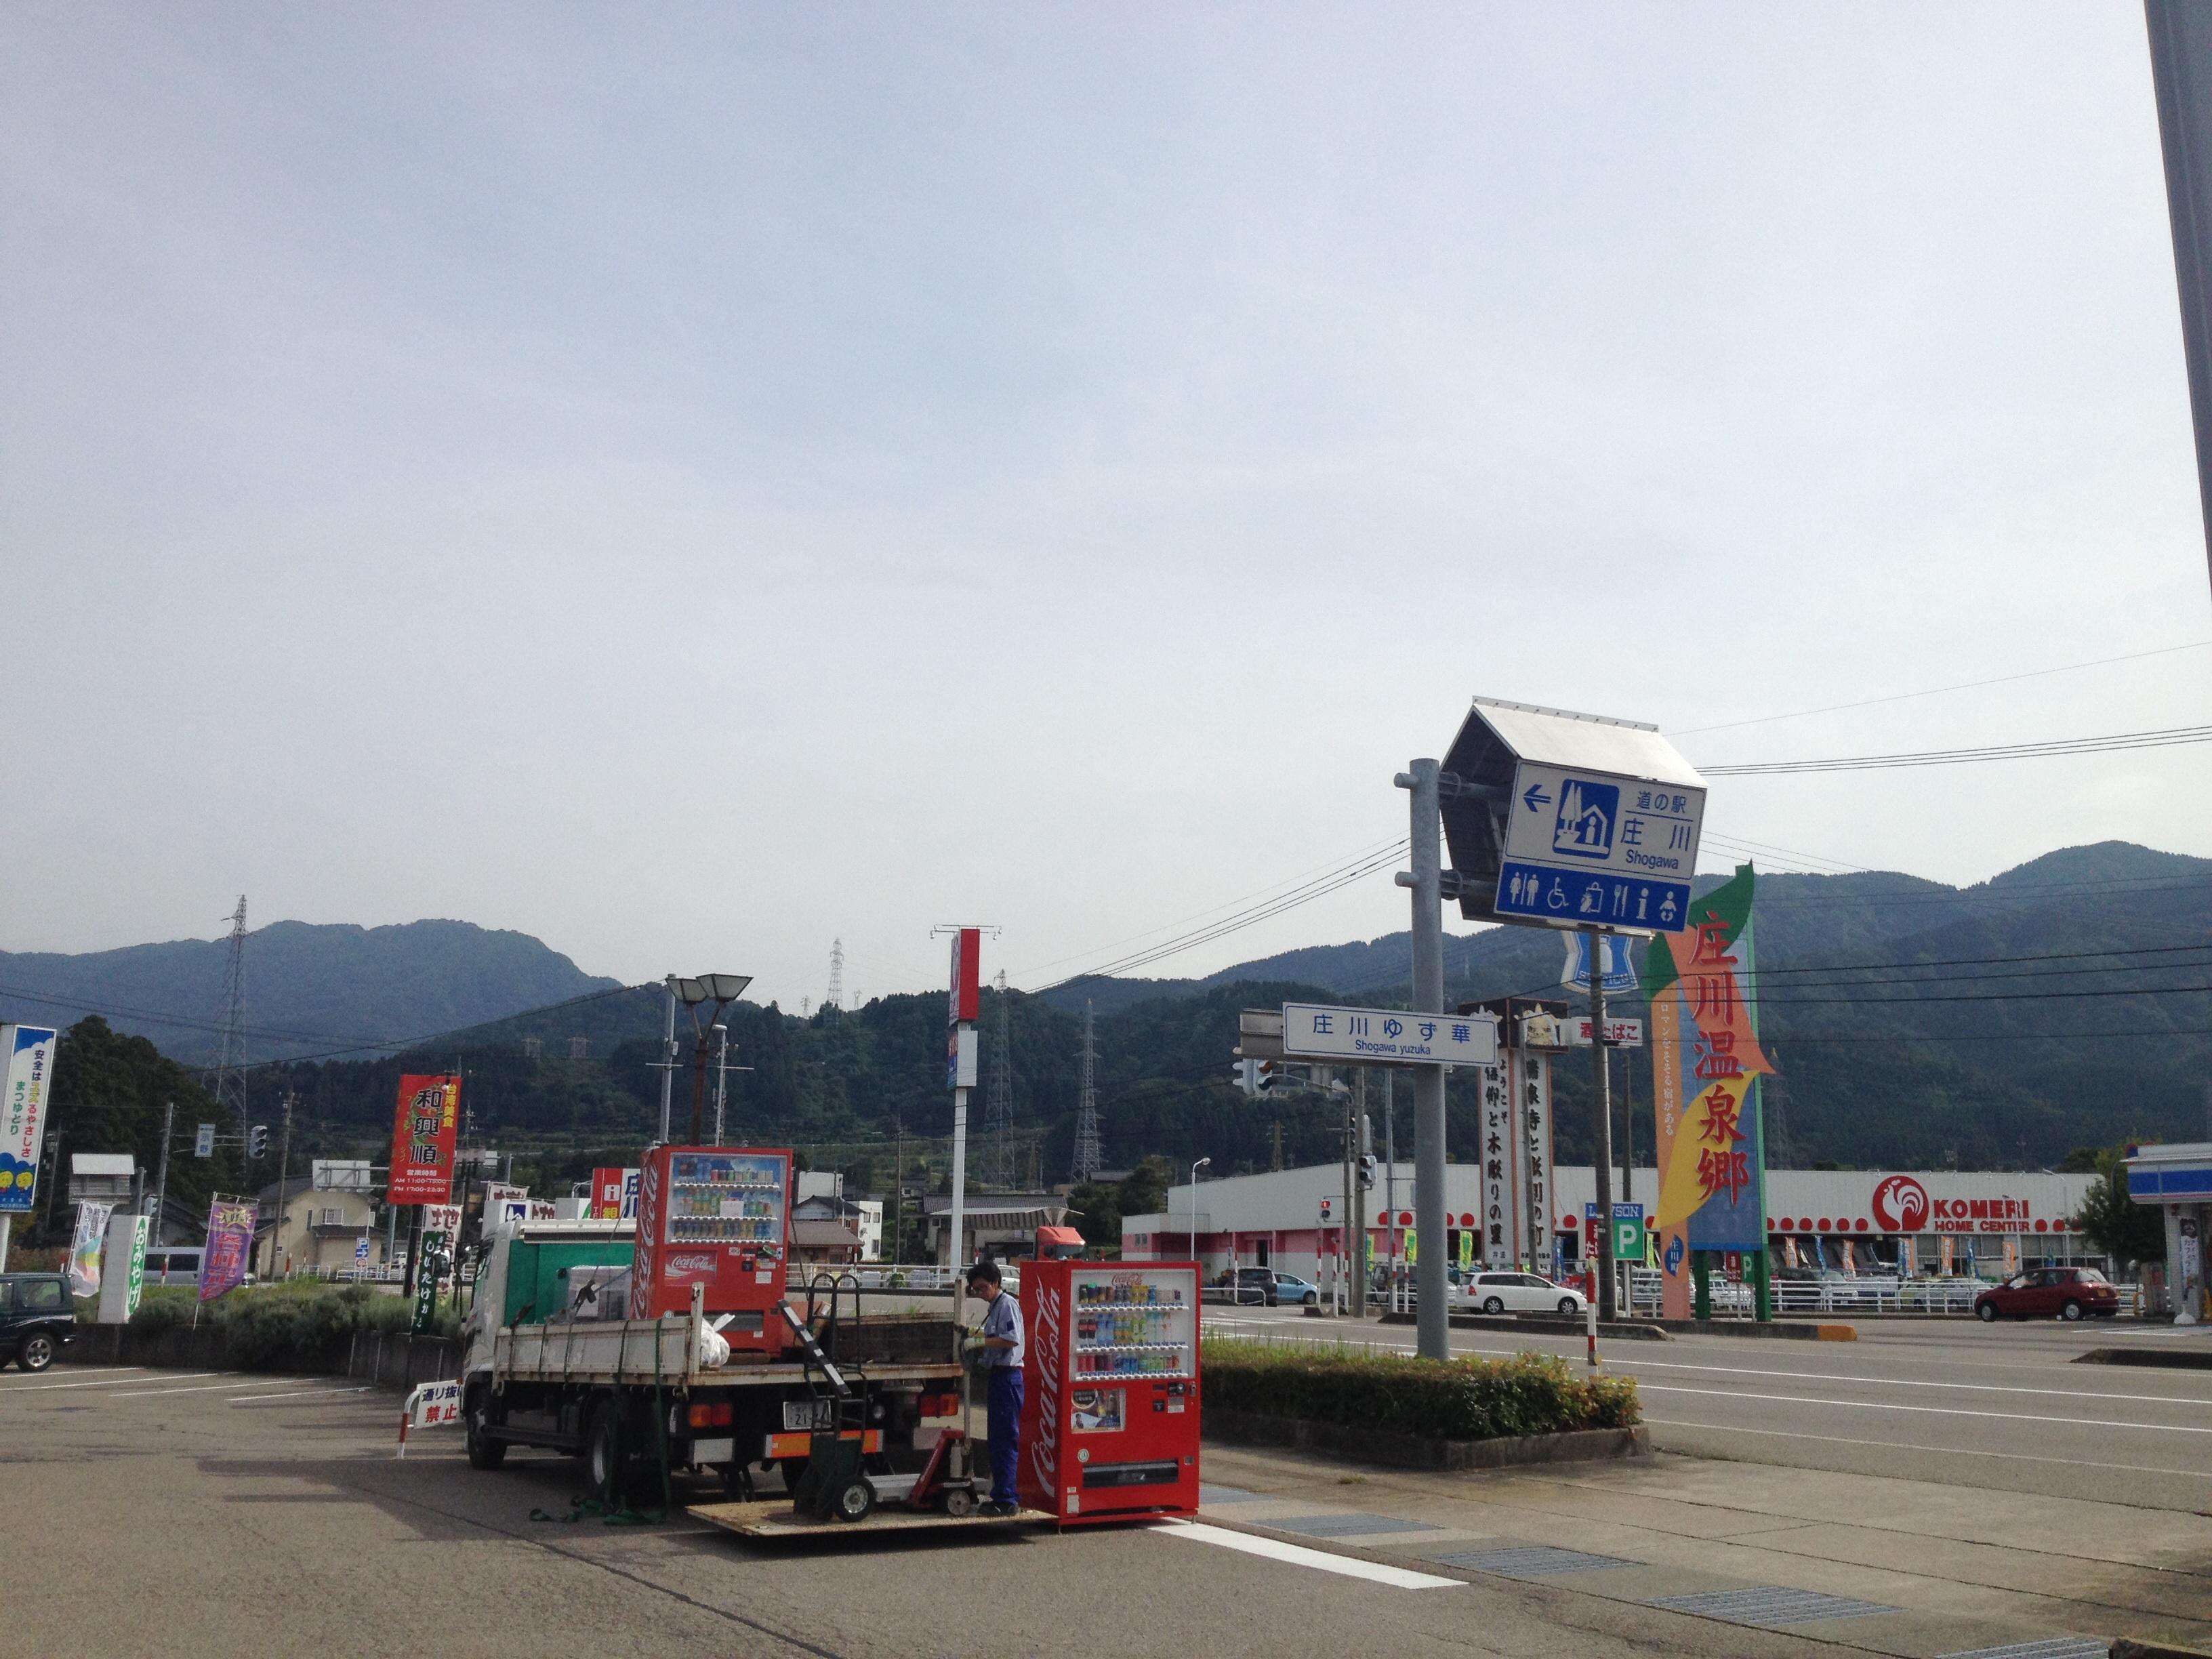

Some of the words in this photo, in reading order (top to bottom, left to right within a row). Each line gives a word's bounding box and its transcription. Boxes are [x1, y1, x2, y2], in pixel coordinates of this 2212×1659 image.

[1637, 790, 1687, 813] 道の駅
[1620, 818, 1691, 851] 庄川
[1626, 849, 1679, 869] Shogawa
[1313, 1014, 1470, 1044] 庄川ゆず華
[1355, 1040, 1397, 1053] Shogawa
[1400, 1044, 1431, 1055] yuzuka
[1689, 910, 1748, 1206] 庄川温泉郷
[1500, 1059, 1508, 1124] ようこそ
[409, 1089, 443, 1164] 和興順
[1589, 1205, 1639, 1217] LSON
[1933, 1199, 2030, 1218] KOMERI
[1619, 1225, 1637, 1253] P
[1935, 1221, 1974, 1232] HOME
[1980, 1221, 2030, 1232] CENTER
[127, 1227, 146, 1305] おみやげ
[672, 1255, 710, 1269] Coca-Cola
[1032, 1275, 1060, 1498] Coca-Cola
[425, 1404, 457, 1422] 禁止
